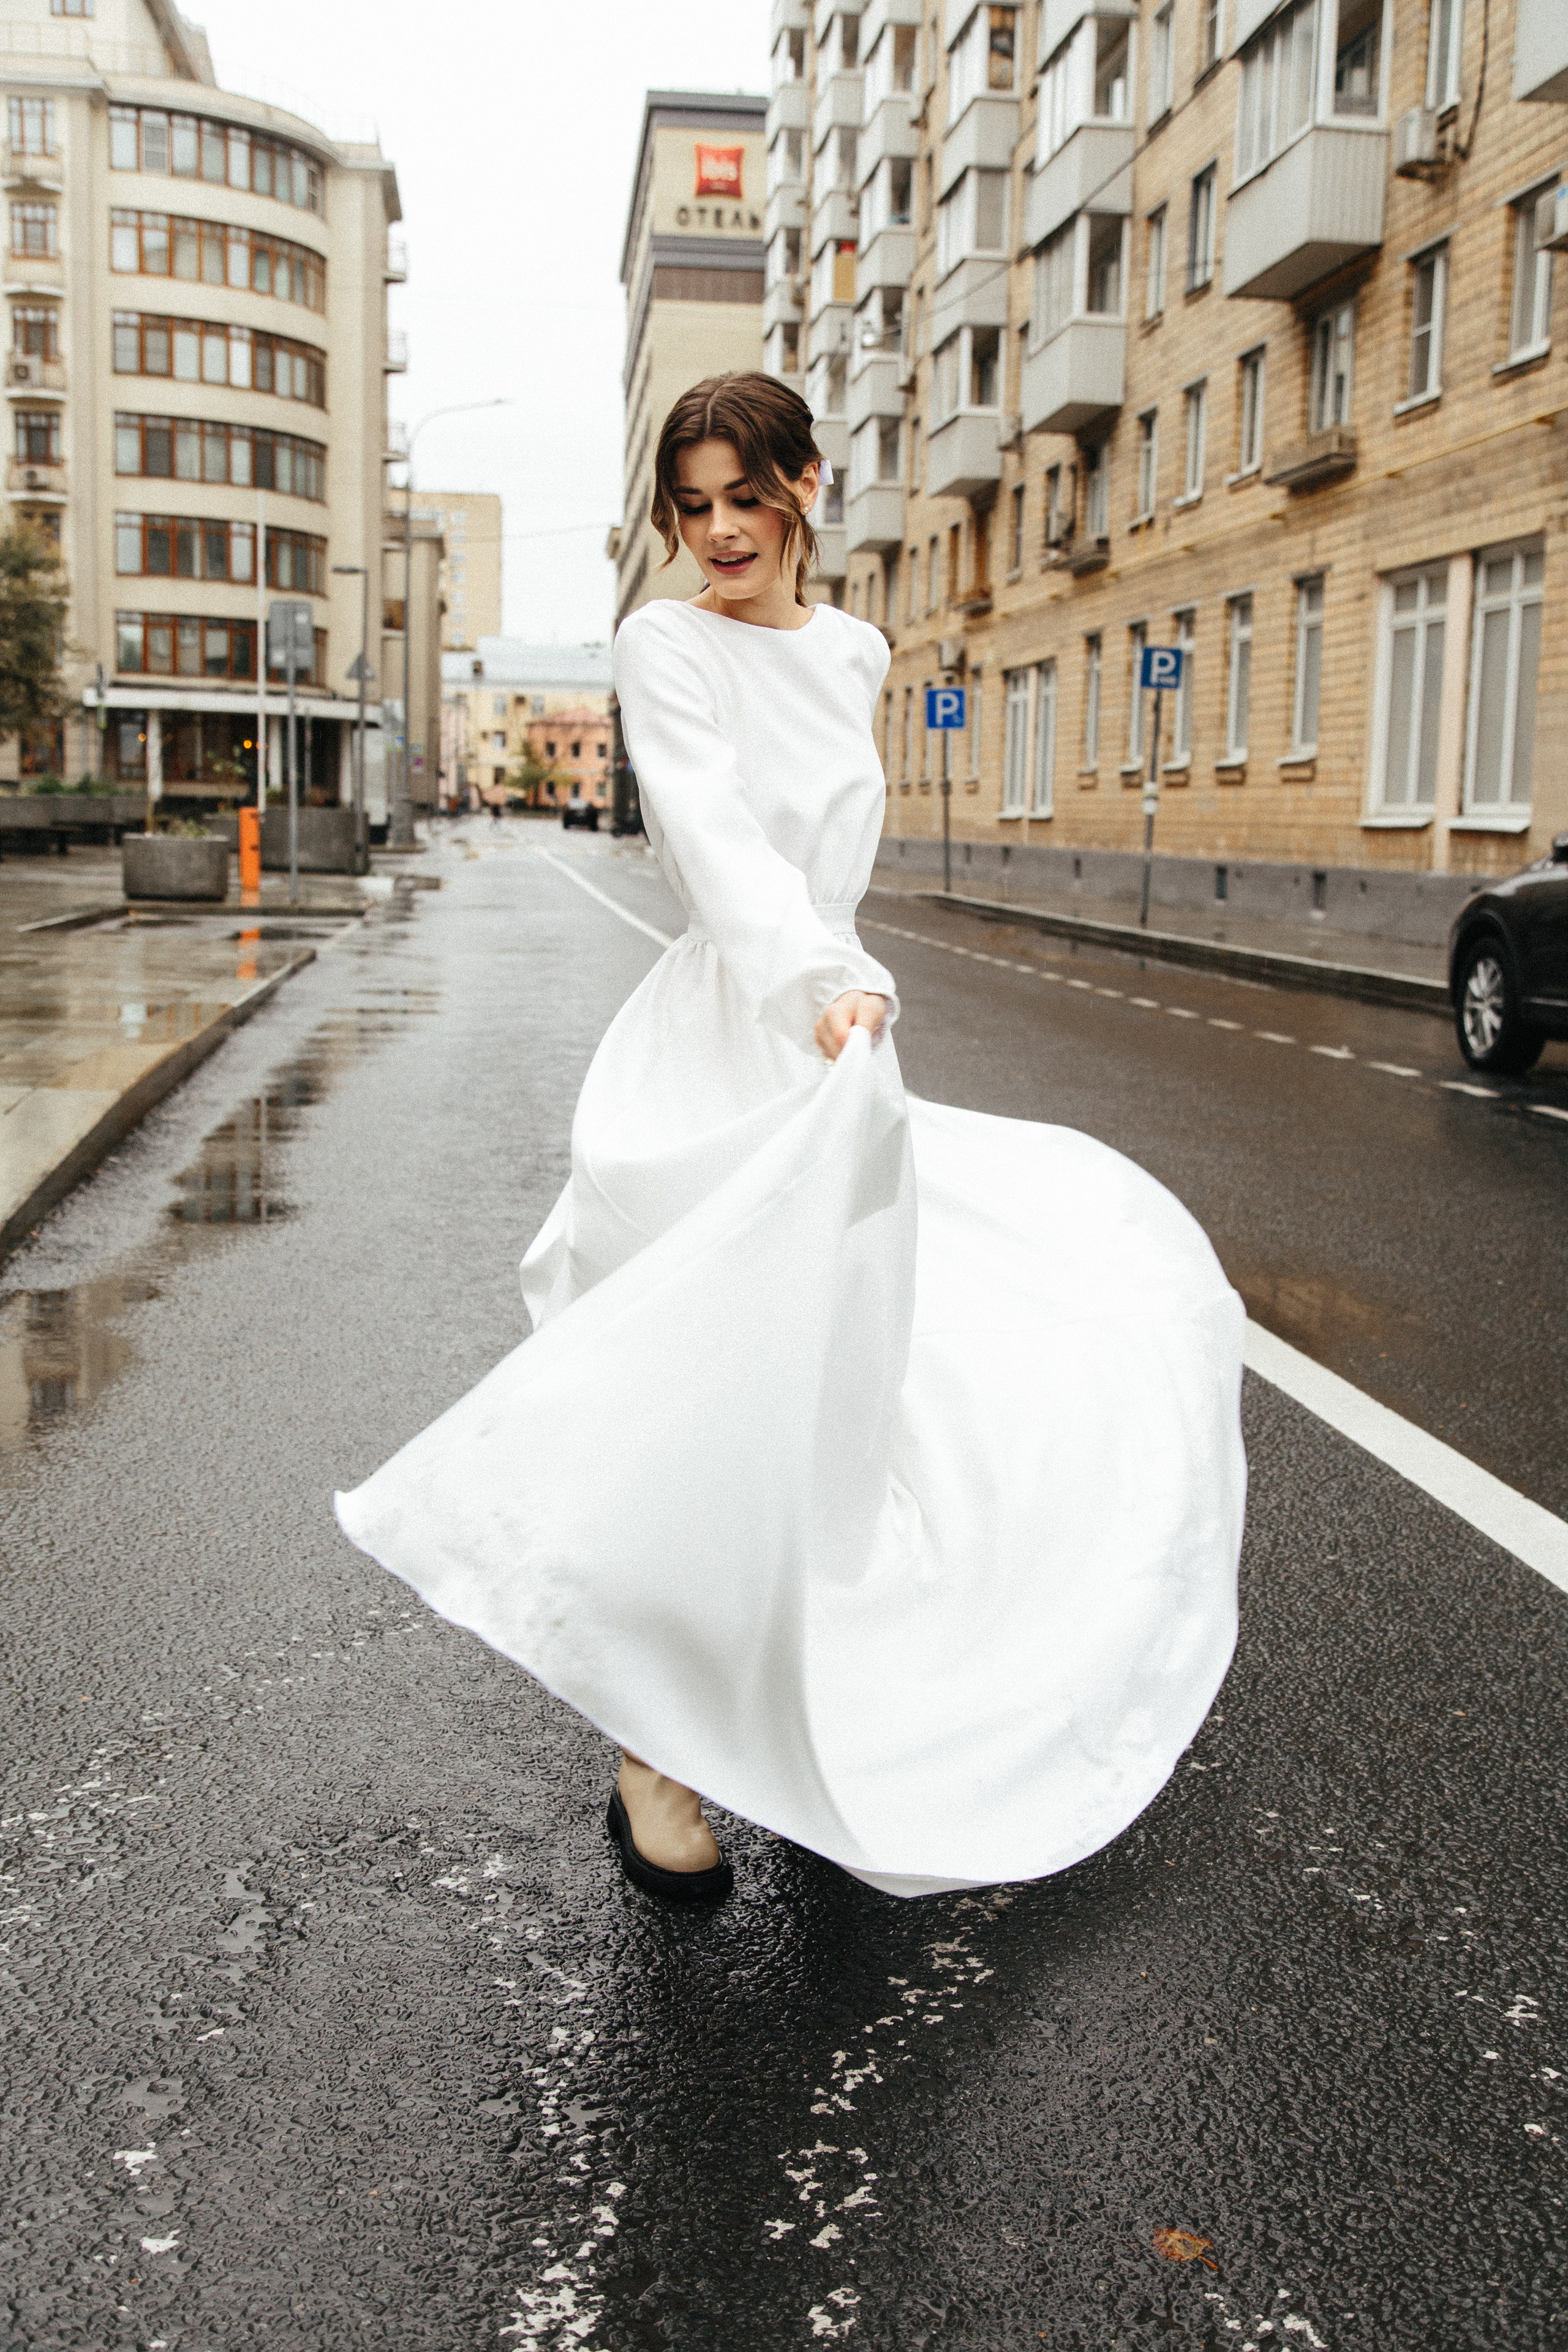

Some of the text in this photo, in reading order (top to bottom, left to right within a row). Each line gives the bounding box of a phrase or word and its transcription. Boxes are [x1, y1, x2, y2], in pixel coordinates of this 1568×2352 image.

[676, 206, 761, 230] ОТЕЛЬ
[1150, 650, 1176, 684] P
[935, 692, 959, 725] P
